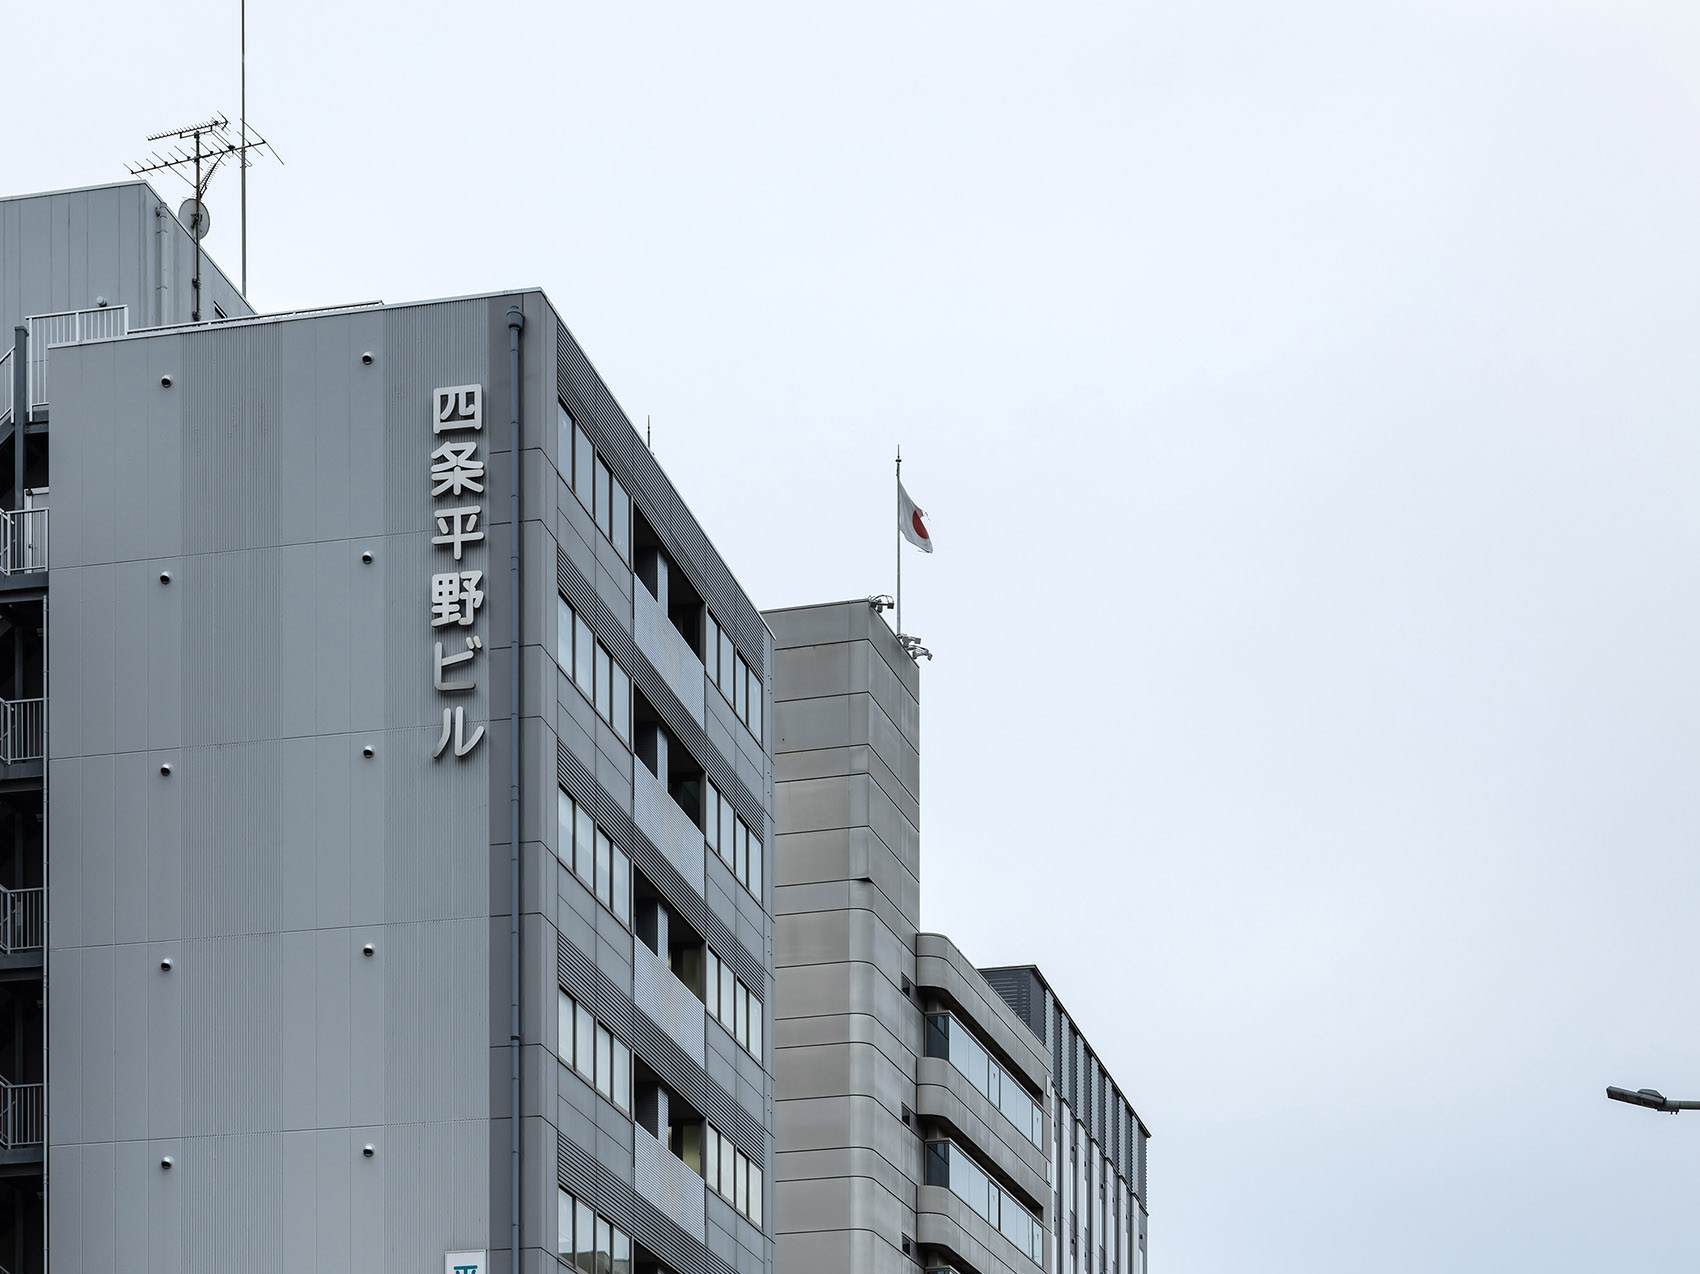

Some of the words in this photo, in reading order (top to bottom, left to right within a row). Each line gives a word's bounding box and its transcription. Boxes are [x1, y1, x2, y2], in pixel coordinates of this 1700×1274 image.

[431, 383, 485, 759] 四条平野ビル
